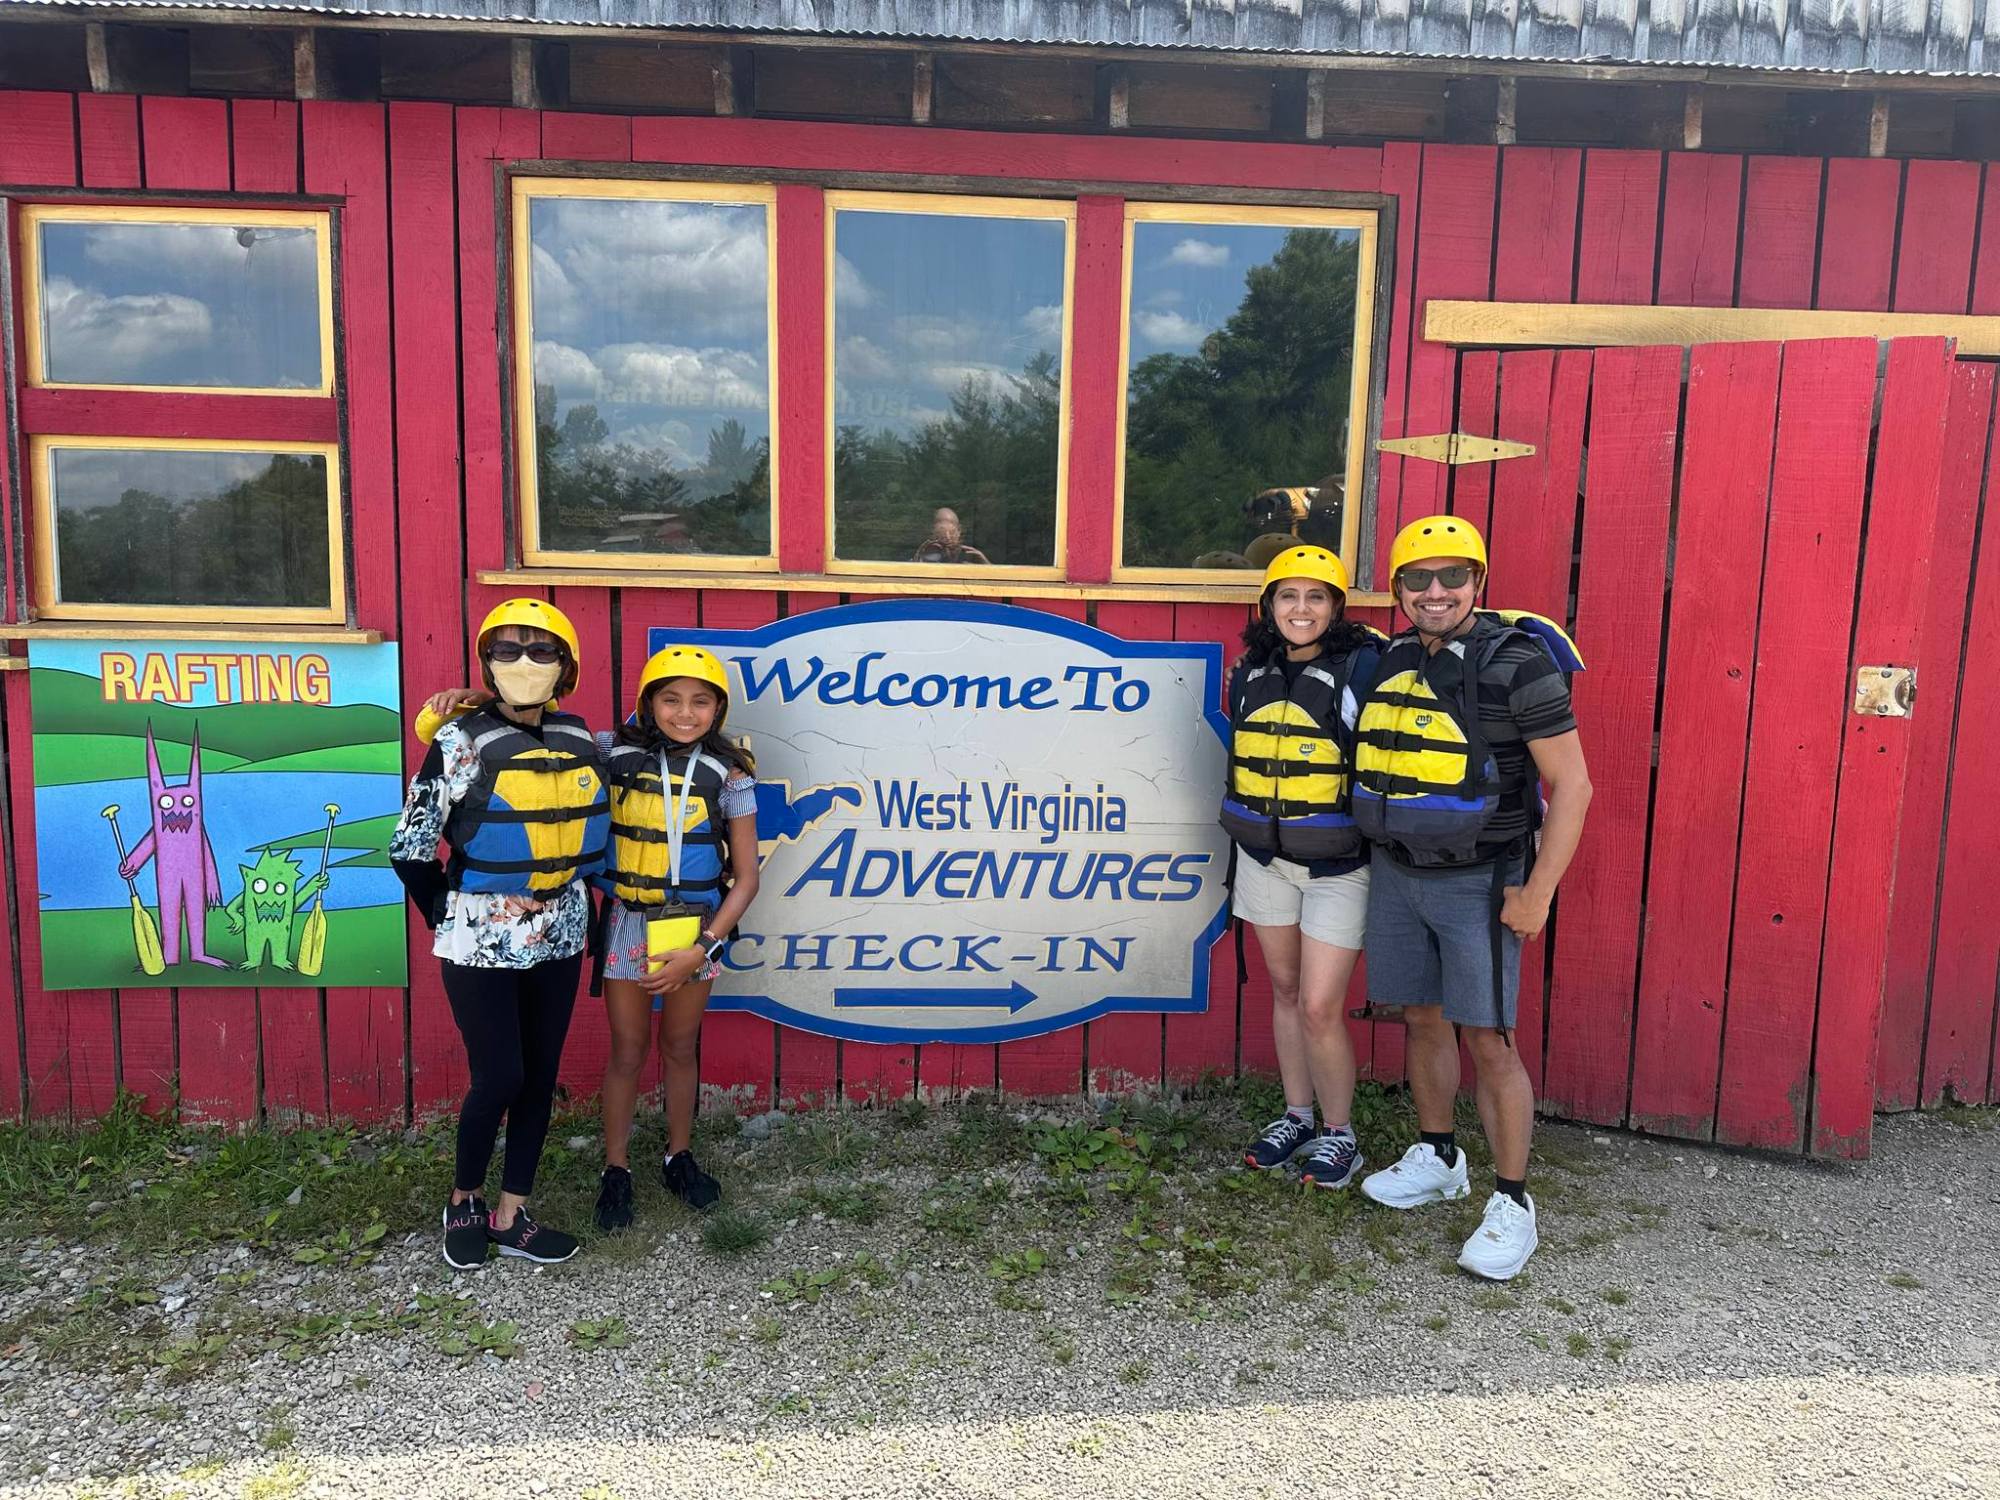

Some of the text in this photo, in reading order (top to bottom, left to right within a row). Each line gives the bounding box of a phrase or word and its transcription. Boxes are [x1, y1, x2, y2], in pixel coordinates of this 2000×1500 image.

[713, 382, 768, 410] Rive
[100, 652, 331, 704] RAFTING
[728, 652, 1150, 712] Welcome To
[874, 779, 1127, 845] West Virginia
[783, 828, 1212, 902] ADVENTURES
[721, 933, 1134, 973] CHECK-IN
